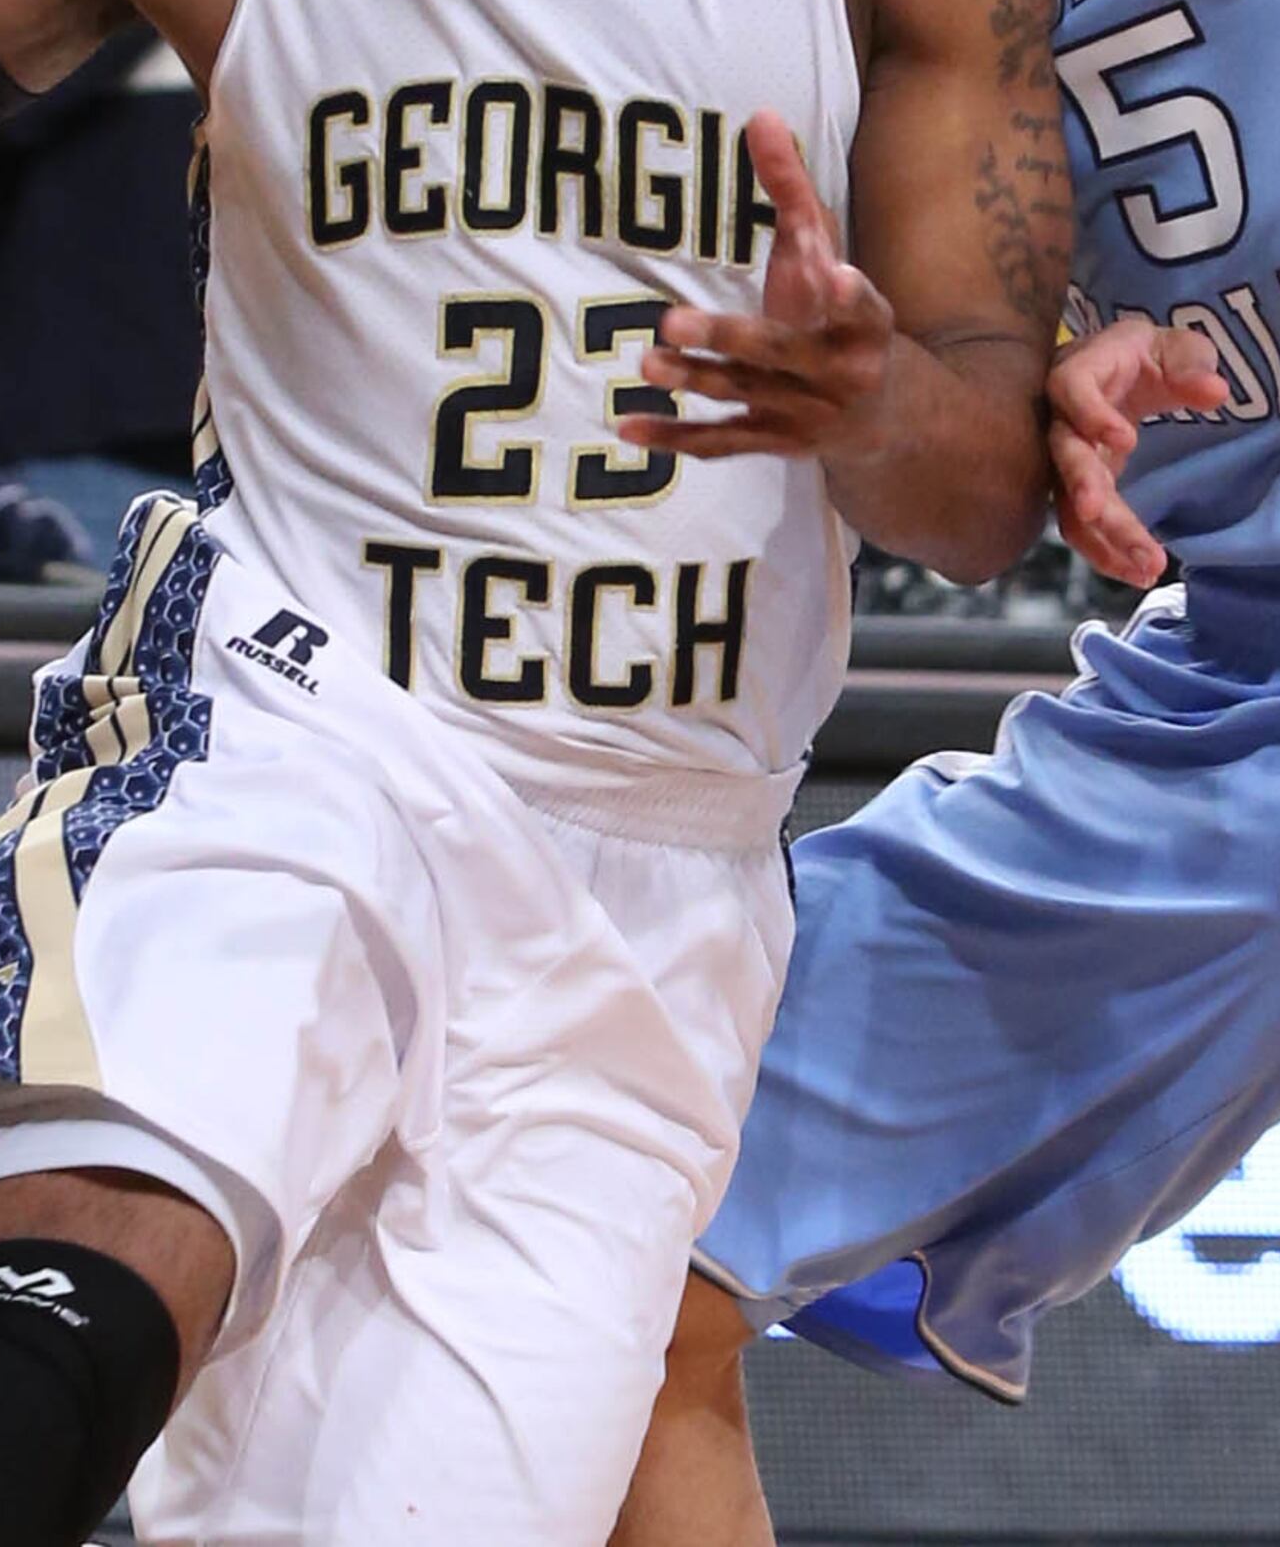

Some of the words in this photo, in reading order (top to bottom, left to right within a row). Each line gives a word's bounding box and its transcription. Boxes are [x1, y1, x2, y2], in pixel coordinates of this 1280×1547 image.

[1055, 0, 1248, 268] 5
[424, 291, 683, 512] 23
[225, 635, 321, 696] RUSSELL
[360, 535, 756, 716] TECH
